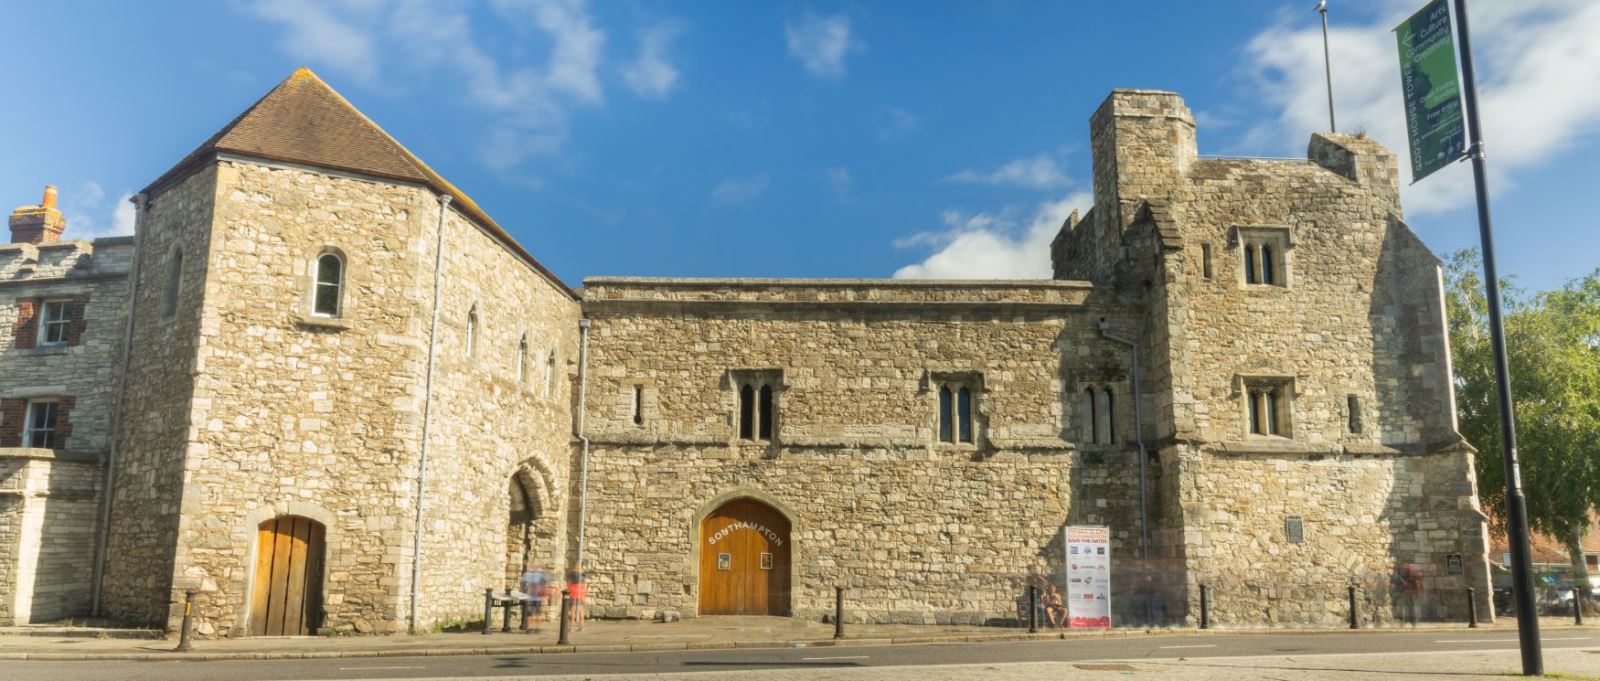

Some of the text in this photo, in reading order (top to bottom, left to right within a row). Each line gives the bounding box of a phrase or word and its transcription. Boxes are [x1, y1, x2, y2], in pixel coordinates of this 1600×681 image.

[1430, 6, 1448, 21] Arts
[1420, 16, 1448, 38] Culture
[1406, 26, 1449, 58] Community
[1404, 62, 1423, 171] GOD'S HOUSE TOWER
[708, 521, 783, 546] SOUTHAMPTON
